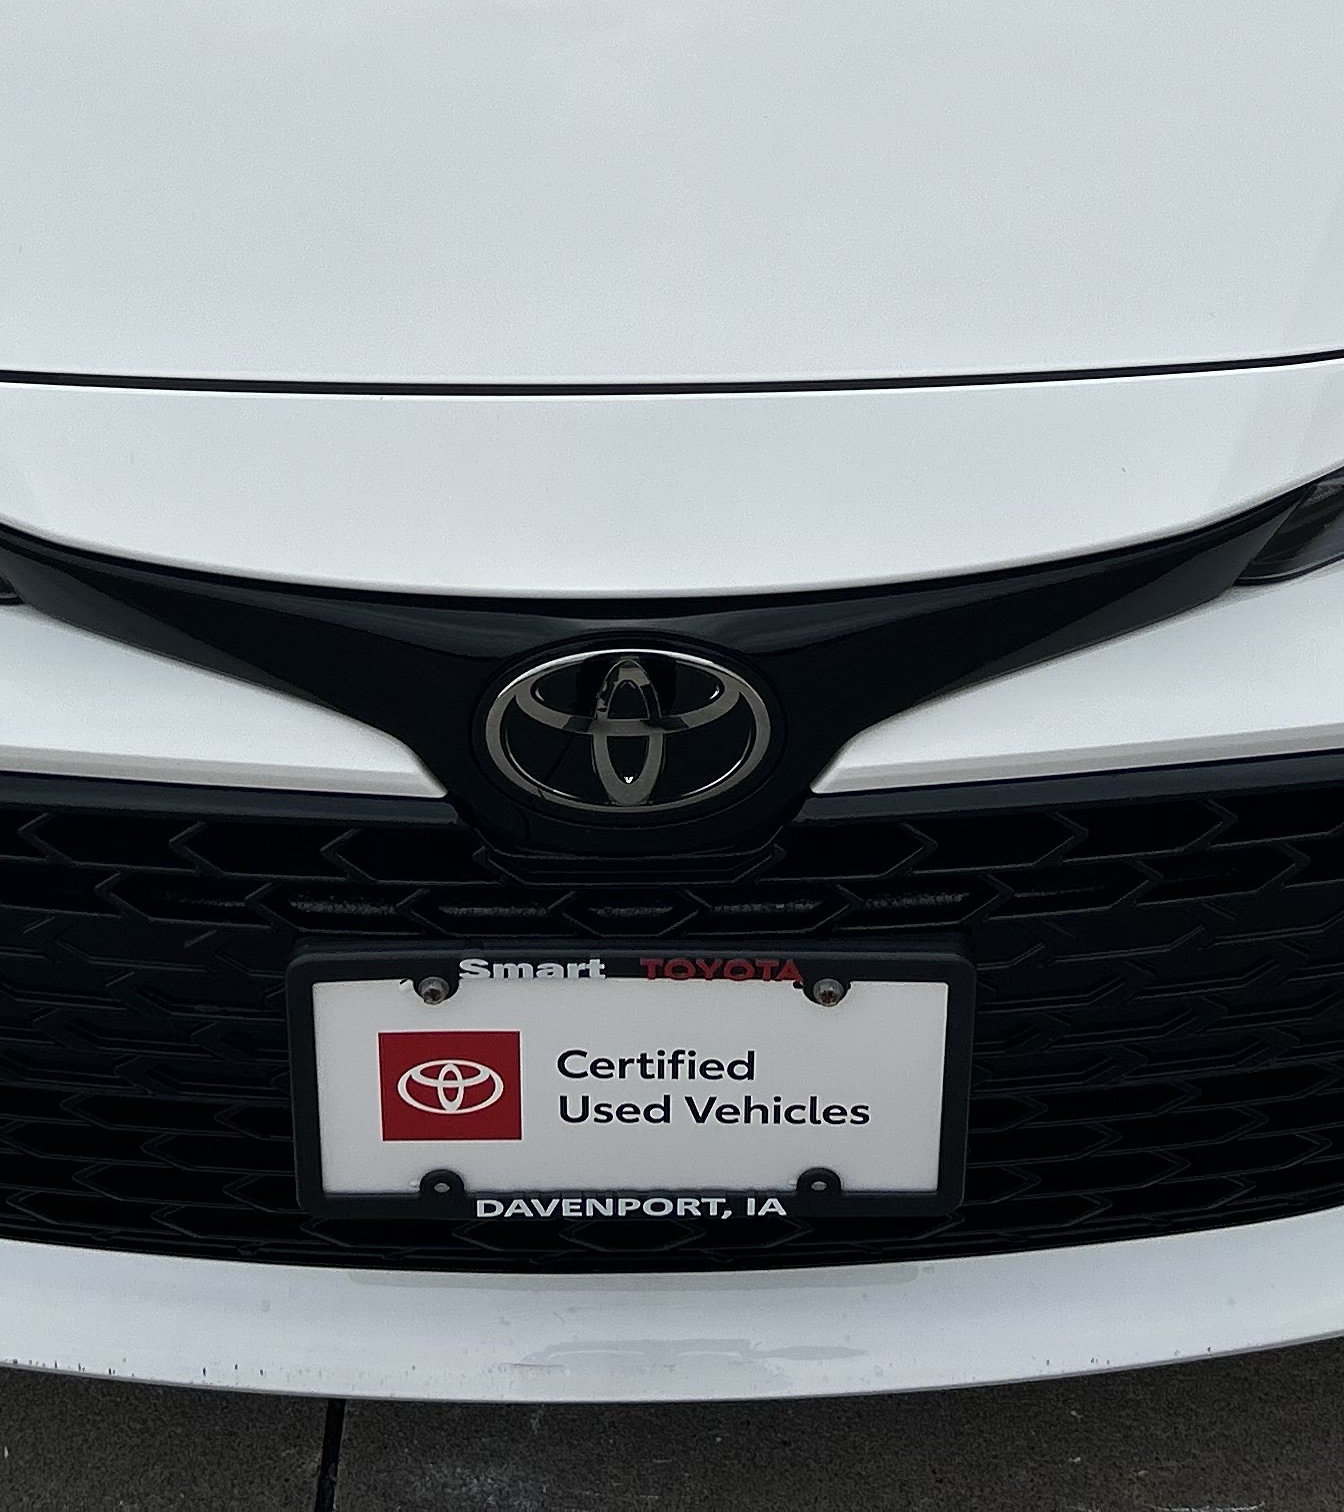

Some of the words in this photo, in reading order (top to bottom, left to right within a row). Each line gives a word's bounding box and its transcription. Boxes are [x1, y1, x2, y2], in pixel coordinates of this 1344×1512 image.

[459, 958, 606, 980] Smart
[639, 957, 804, 981] TOYOTA
[557, 1049, 756, 1081] Certified
[559, 1094, 671, 1124] Used
[684, 1094, 871, 1125] Vehicles
[476, 1197, 733, 1220] DAVENPORT,
[746, 1197, 788, 1217] IA
